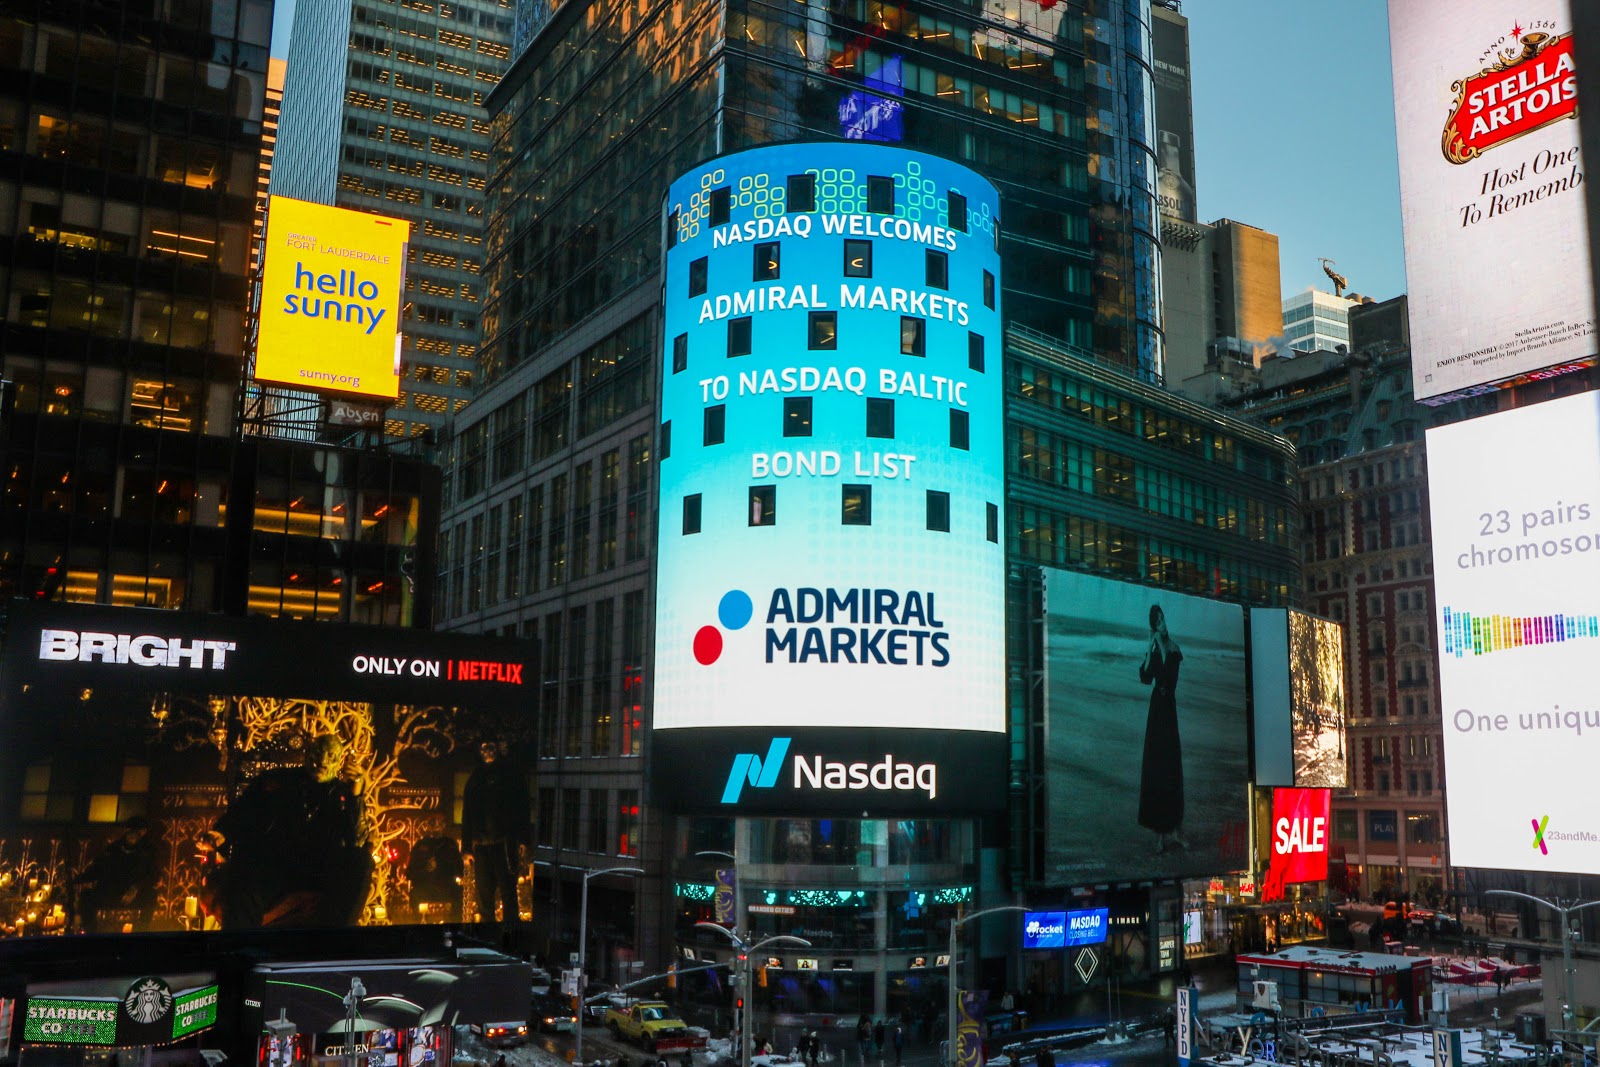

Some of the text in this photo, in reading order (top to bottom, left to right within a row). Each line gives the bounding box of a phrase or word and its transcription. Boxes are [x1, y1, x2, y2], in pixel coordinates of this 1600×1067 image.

[1479, 20, 1556, 64] ANNO 1366
[1169, 64, 1185, 76] YORK
[1468, 52, 1577, 114] STELLA
[1469, 75, 1579, 140] ARTOIS
[1480, 146, 1579, 196] Host One
[1460, 203, 1482, 228] To
[288, 232, 317, 242] GREATER
[713, 214, 957, 251] NASDAQ WELCOMES
[287, 239, 390, 264] FORT LAUDERDALE
[295, 261, 379, 300] hello
[283, 294, 386, 335] sunny
[699, 284, 969, 326] ADMIRAL MARKETS
[1514, 321, 1565, 338] StellaArtois.com
[1436, 357, 1456, 368] ENJOY
[1457, 345, 1498, 362] RESPONSIBLY
[1473, 352, 1498, 366] Imported
[1527, 340, 1547, 351] Brands
[299, 368, 360, 387] sunny.org
[699, 366, 968, 406] TO NASDAQ BALTIC
[334, 406, 379, 423] Absen
[752, 450, 916, 480] BOND LIST
[1479, 500, 1591, 537] 23 pairs
[1457, 532, 1600, 569] chromoso
[766, 587, 944, 628] ADMIRAL
[38, 628, 236, 671] BRIGHT
[765, 627, 950, 667] MARKETS
[352, 655, 523, 685] ONLY ON NETFLIX
[1454, 709, 1509, 732] One
[794, 754, 937, 800] Nasdaq
[1275, 816, 1325, 855] SALE
[775, 906, 795, 914] CITIES
[803, 929, 833, 939] Nasdaq
[1037, 924, 1063, 934] rocket
[28, 1006, 115, 1022] STARBUCKS
[175, 992, 218, 1017] STARBUCKS
[245, 999, 261, 1008] CITIZEN
[41, 1022, 96, 1035] COFFEE
[1179, 991, 1189, 1056] NYPD
[325, 1043, 370, 1056] CITEN
